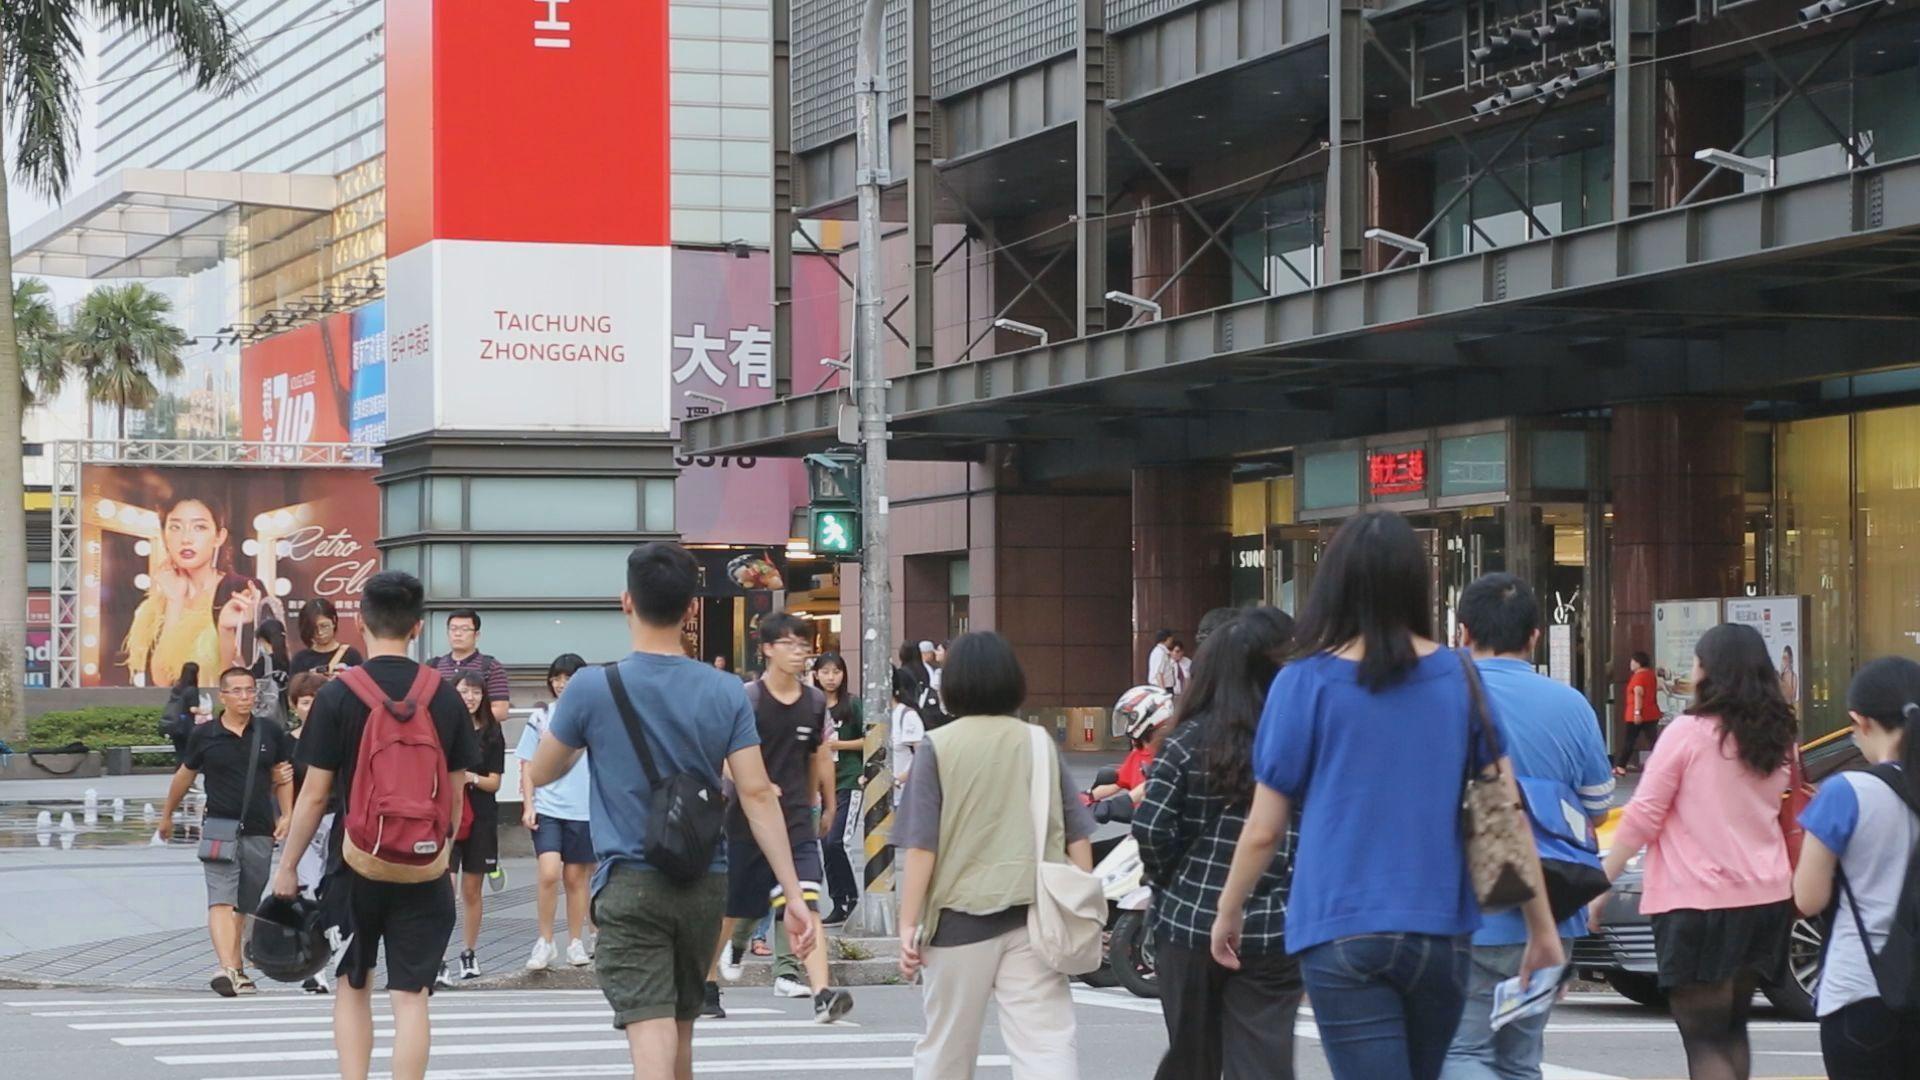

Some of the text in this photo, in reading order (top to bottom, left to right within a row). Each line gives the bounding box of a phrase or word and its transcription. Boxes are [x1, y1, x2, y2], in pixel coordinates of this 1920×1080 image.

[494, 310, 612, 333] TAICHUNG
[480, 339, 625, 363] ZHONGGANG
[280, 525, 362, 560] Retro
